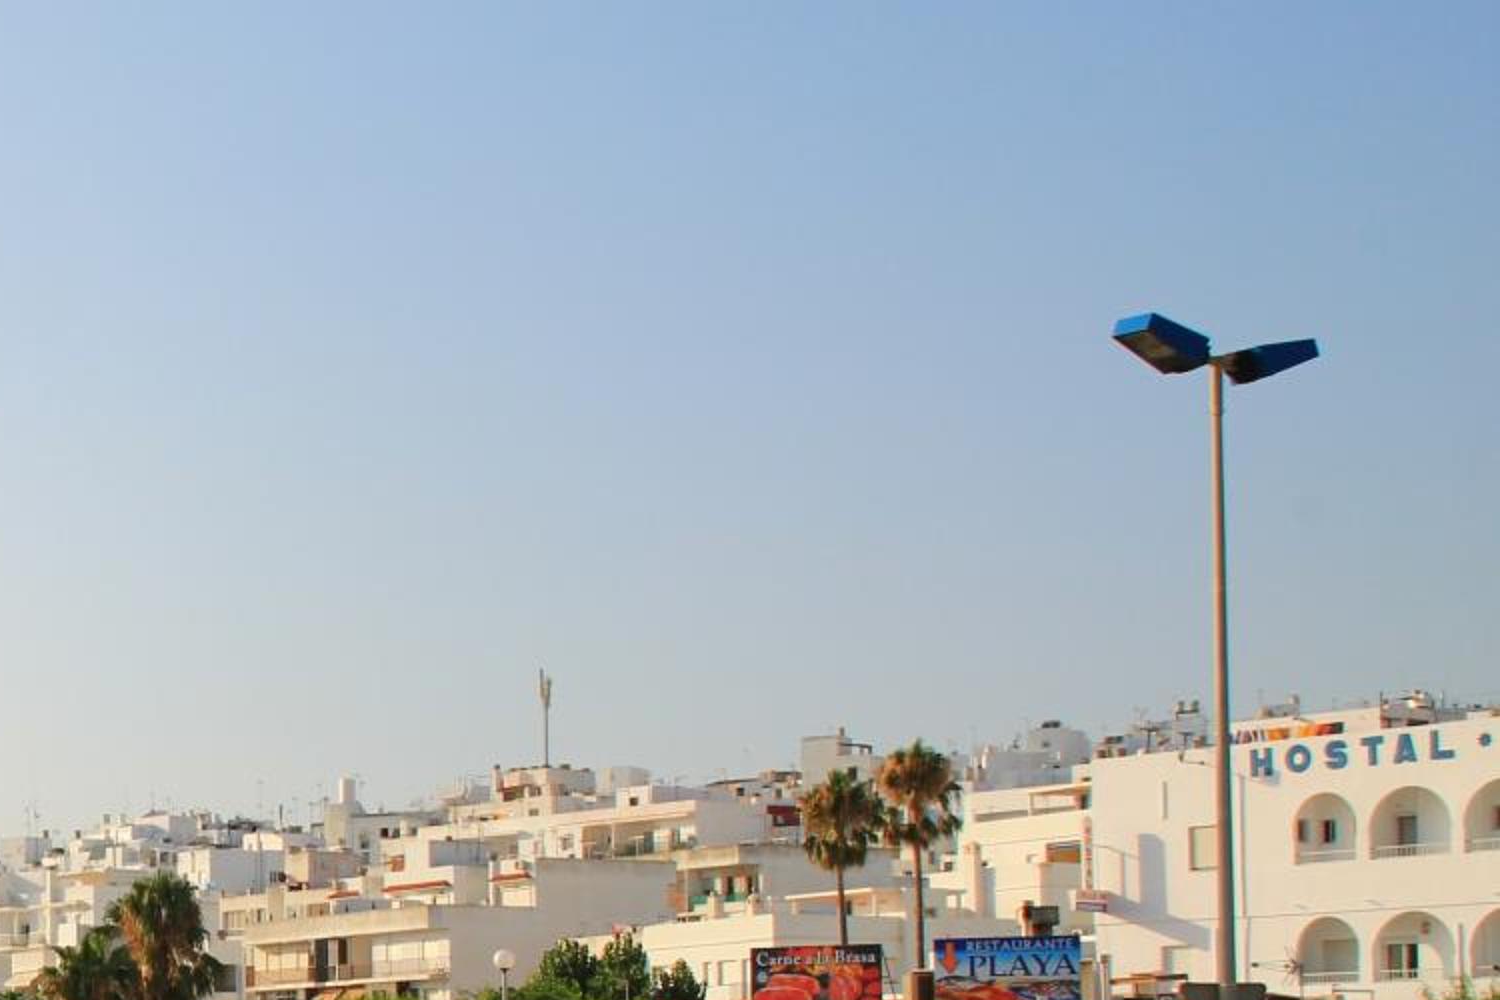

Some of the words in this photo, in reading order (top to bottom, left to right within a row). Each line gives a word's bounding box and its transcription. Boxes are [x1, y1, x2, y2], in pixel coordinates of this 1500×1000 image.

[1250, 730, 1455, 777] HOSTAL
[965, 938, 1074, 951] RESTAURANTE
[967, 953, 1079, 977] PLAYA
